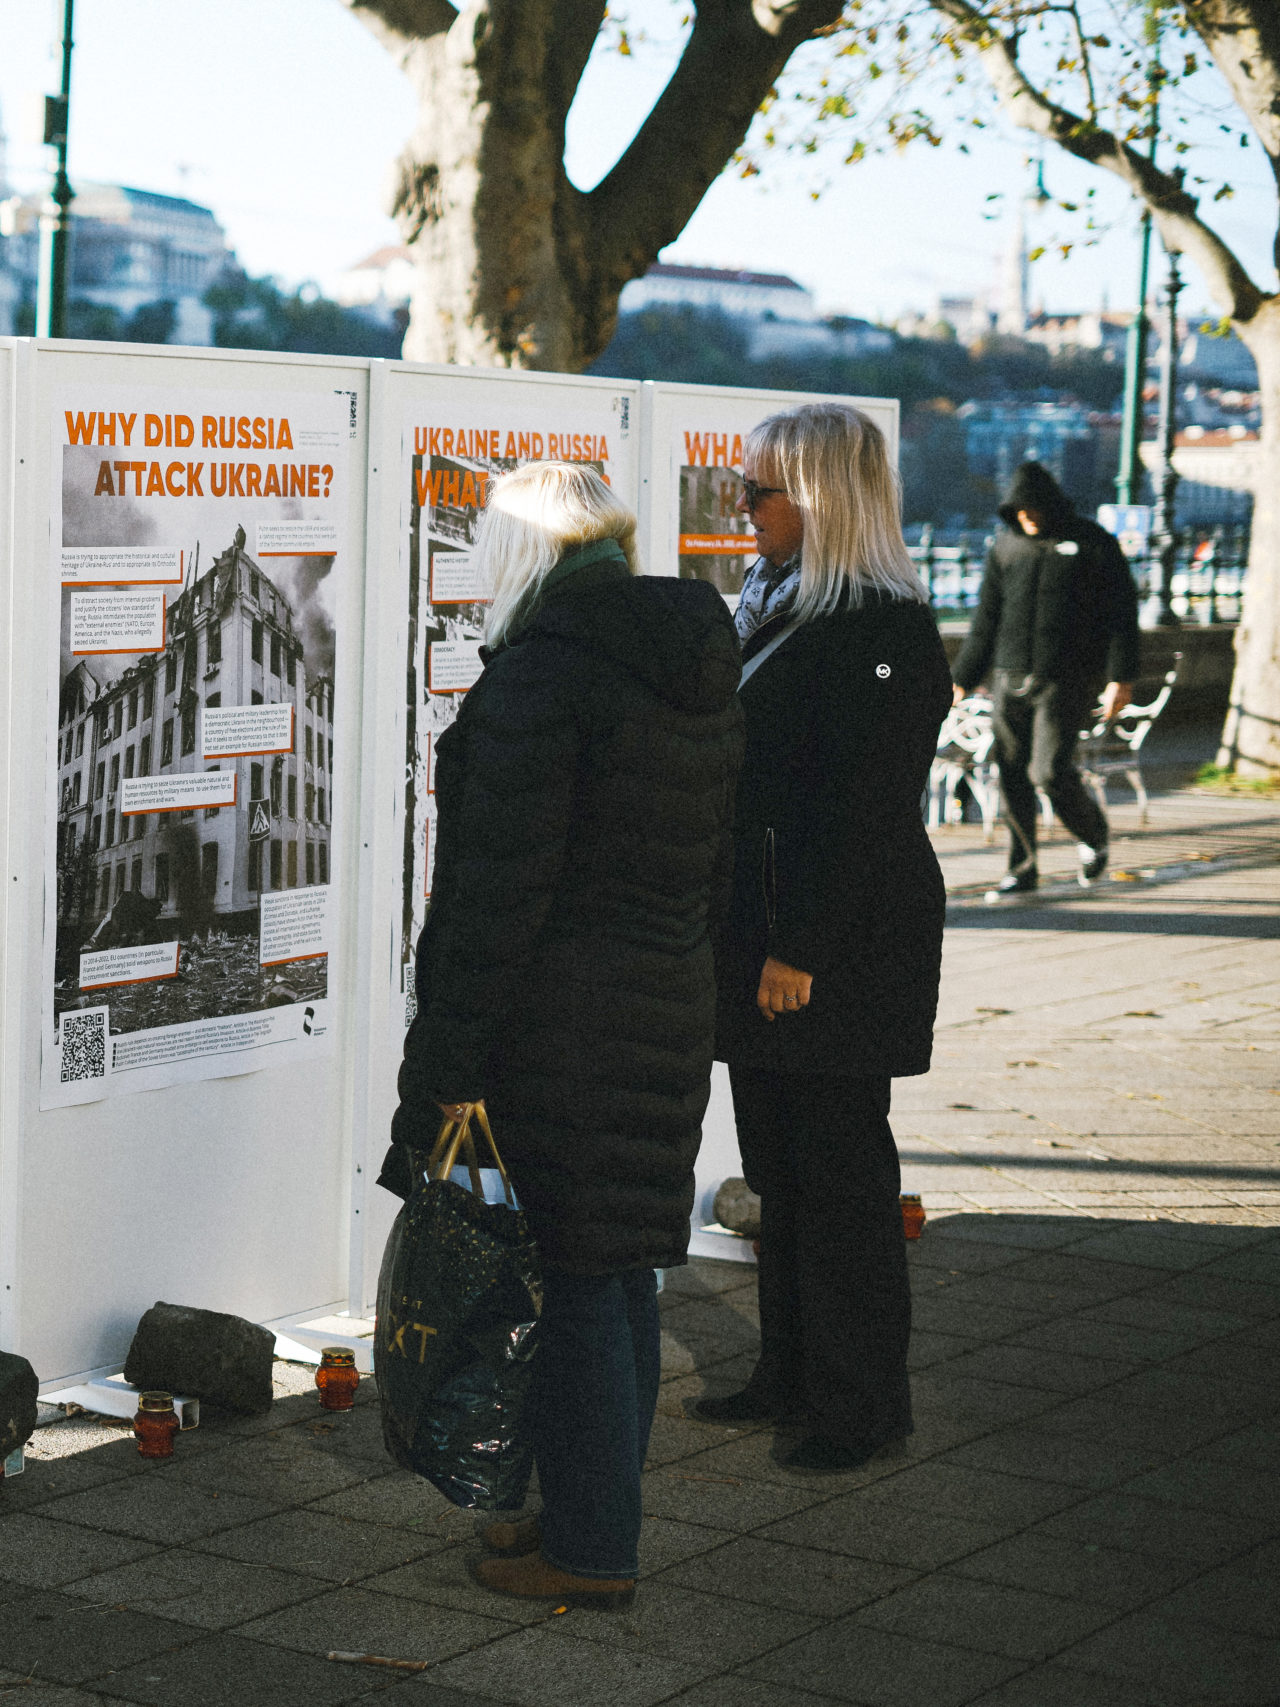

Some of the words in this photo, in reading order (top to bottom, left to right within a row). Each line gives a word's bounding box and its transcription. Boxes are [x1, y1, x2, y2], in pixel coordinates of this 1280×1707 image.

[65, 411, 137, 446] WHY
[145, 414, 195, 447] DID
[202, 416, 293, 450] RUSSIA
[414, 427, 500, 458] UKRAINE
[505, 431, 543, 459] AND
[548, 433, 609, 462] RUSSIA
[684, 431, 746, 468] WHA
[94, 461, 204, 497] ATTACK
[211, 463, 334, 498] UKRAINE?
[415, 469, 489, 508] WHAT
